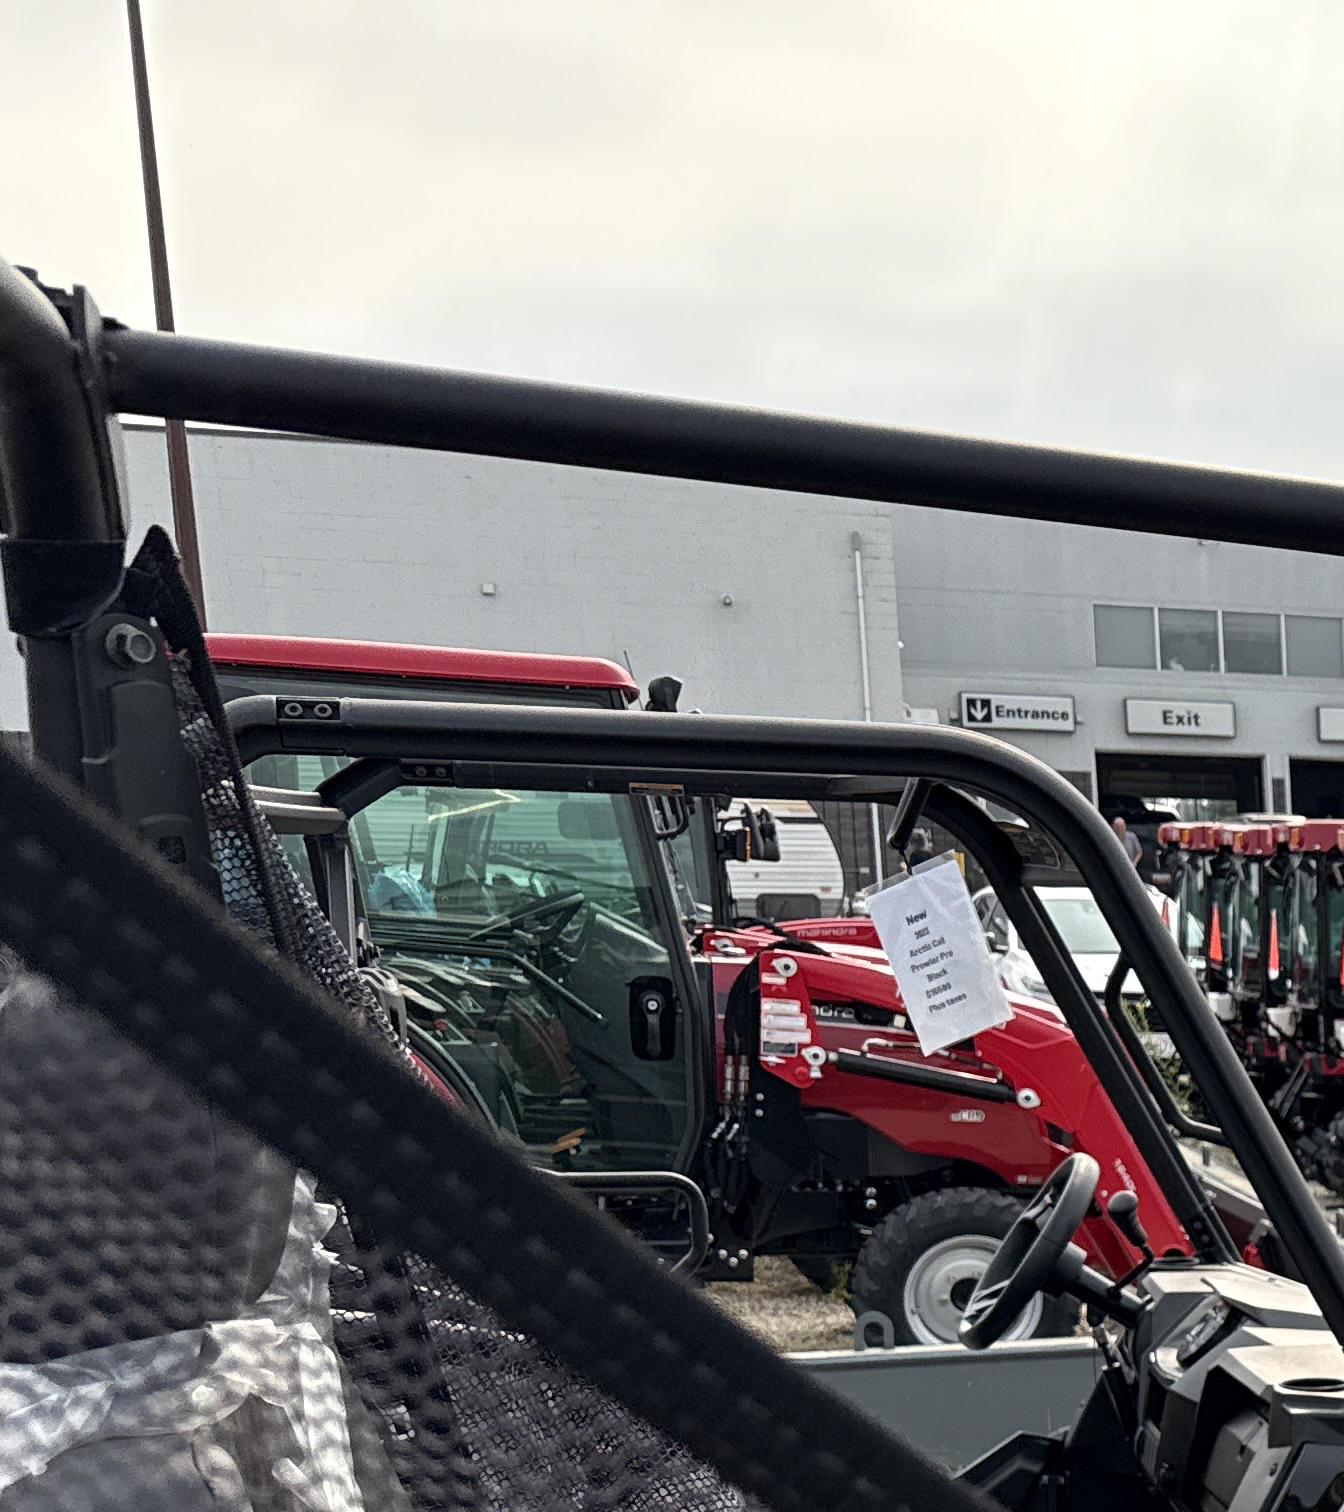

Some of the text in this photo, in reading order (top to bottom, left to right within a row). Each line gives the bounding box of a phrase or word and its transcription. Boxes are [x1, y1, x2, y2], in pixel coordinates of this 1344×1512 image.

[995, 705, 1070, 722] Entrance
[1161, 709, 1201, 728] Exit
[905, 910, 927, 926] New
